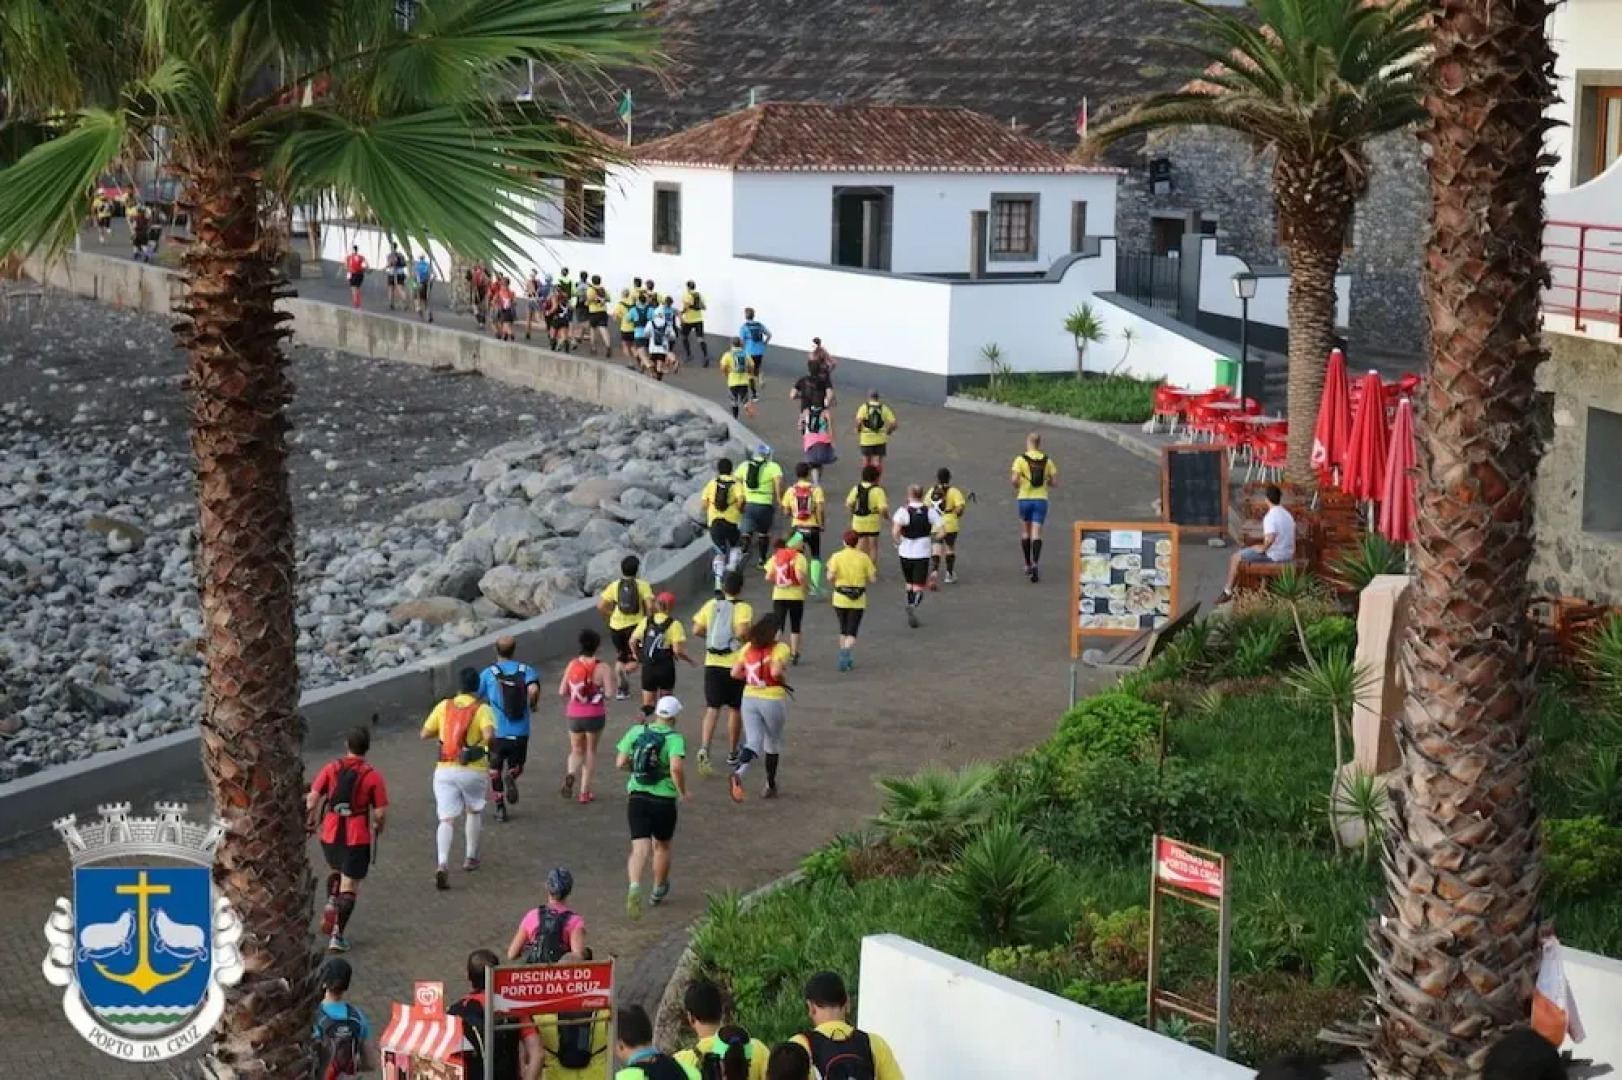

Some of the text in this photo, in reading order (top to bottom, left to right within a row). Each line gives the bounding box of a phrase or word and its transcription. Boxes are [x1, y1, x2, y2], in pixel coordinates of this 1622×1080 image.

[510, 969, 591, 983] PISCINAS DO
[500, 981, 600, 997] PORTO DA CRUZ
